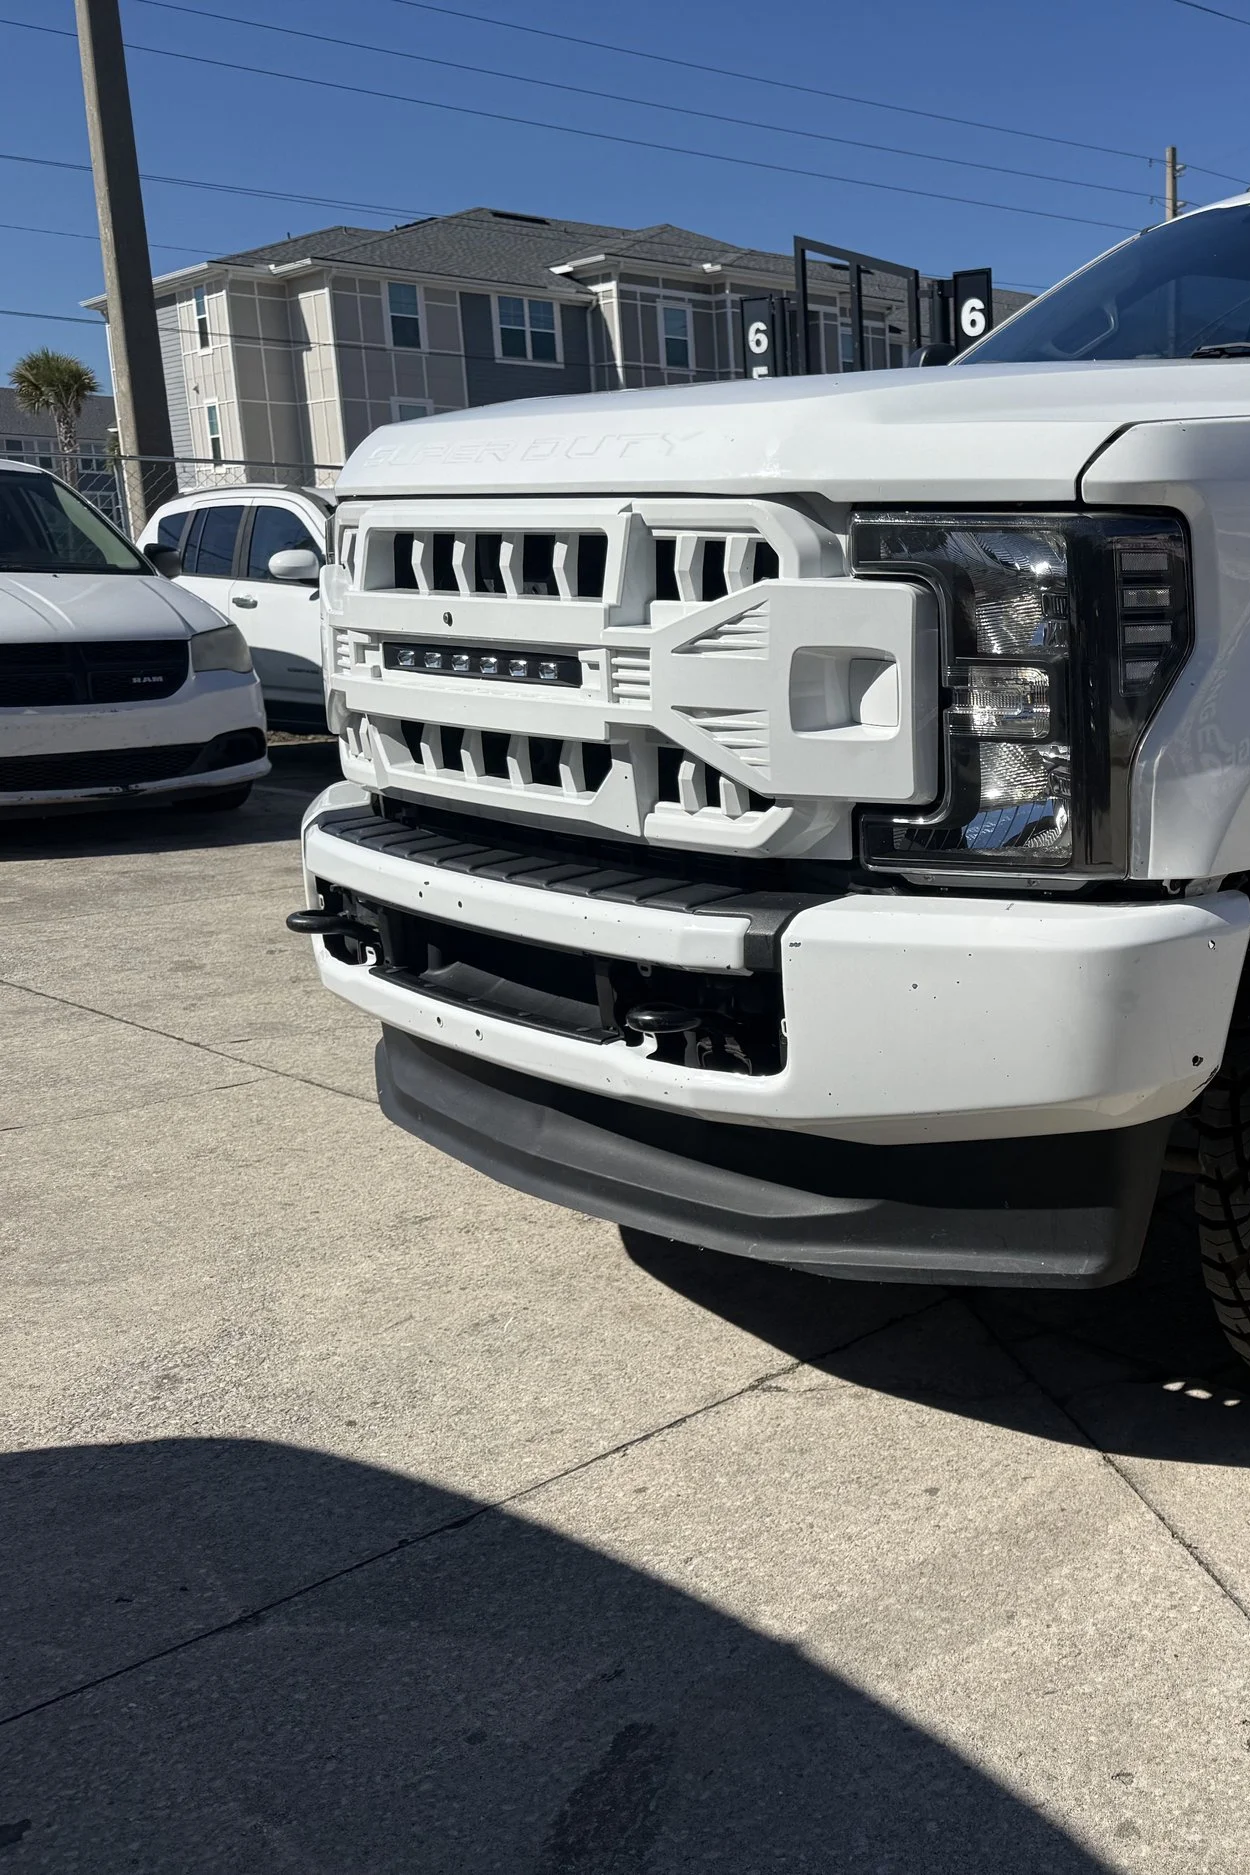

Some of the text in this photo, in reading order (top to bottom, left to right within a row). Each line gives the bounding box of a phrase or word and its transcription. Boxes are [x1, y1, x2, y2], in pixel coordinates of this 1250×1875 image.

[960, 298, 986, 337] 6
[748, 321, 769, 354] 6
[363, 431, 704, 467] SUPER DUTY
